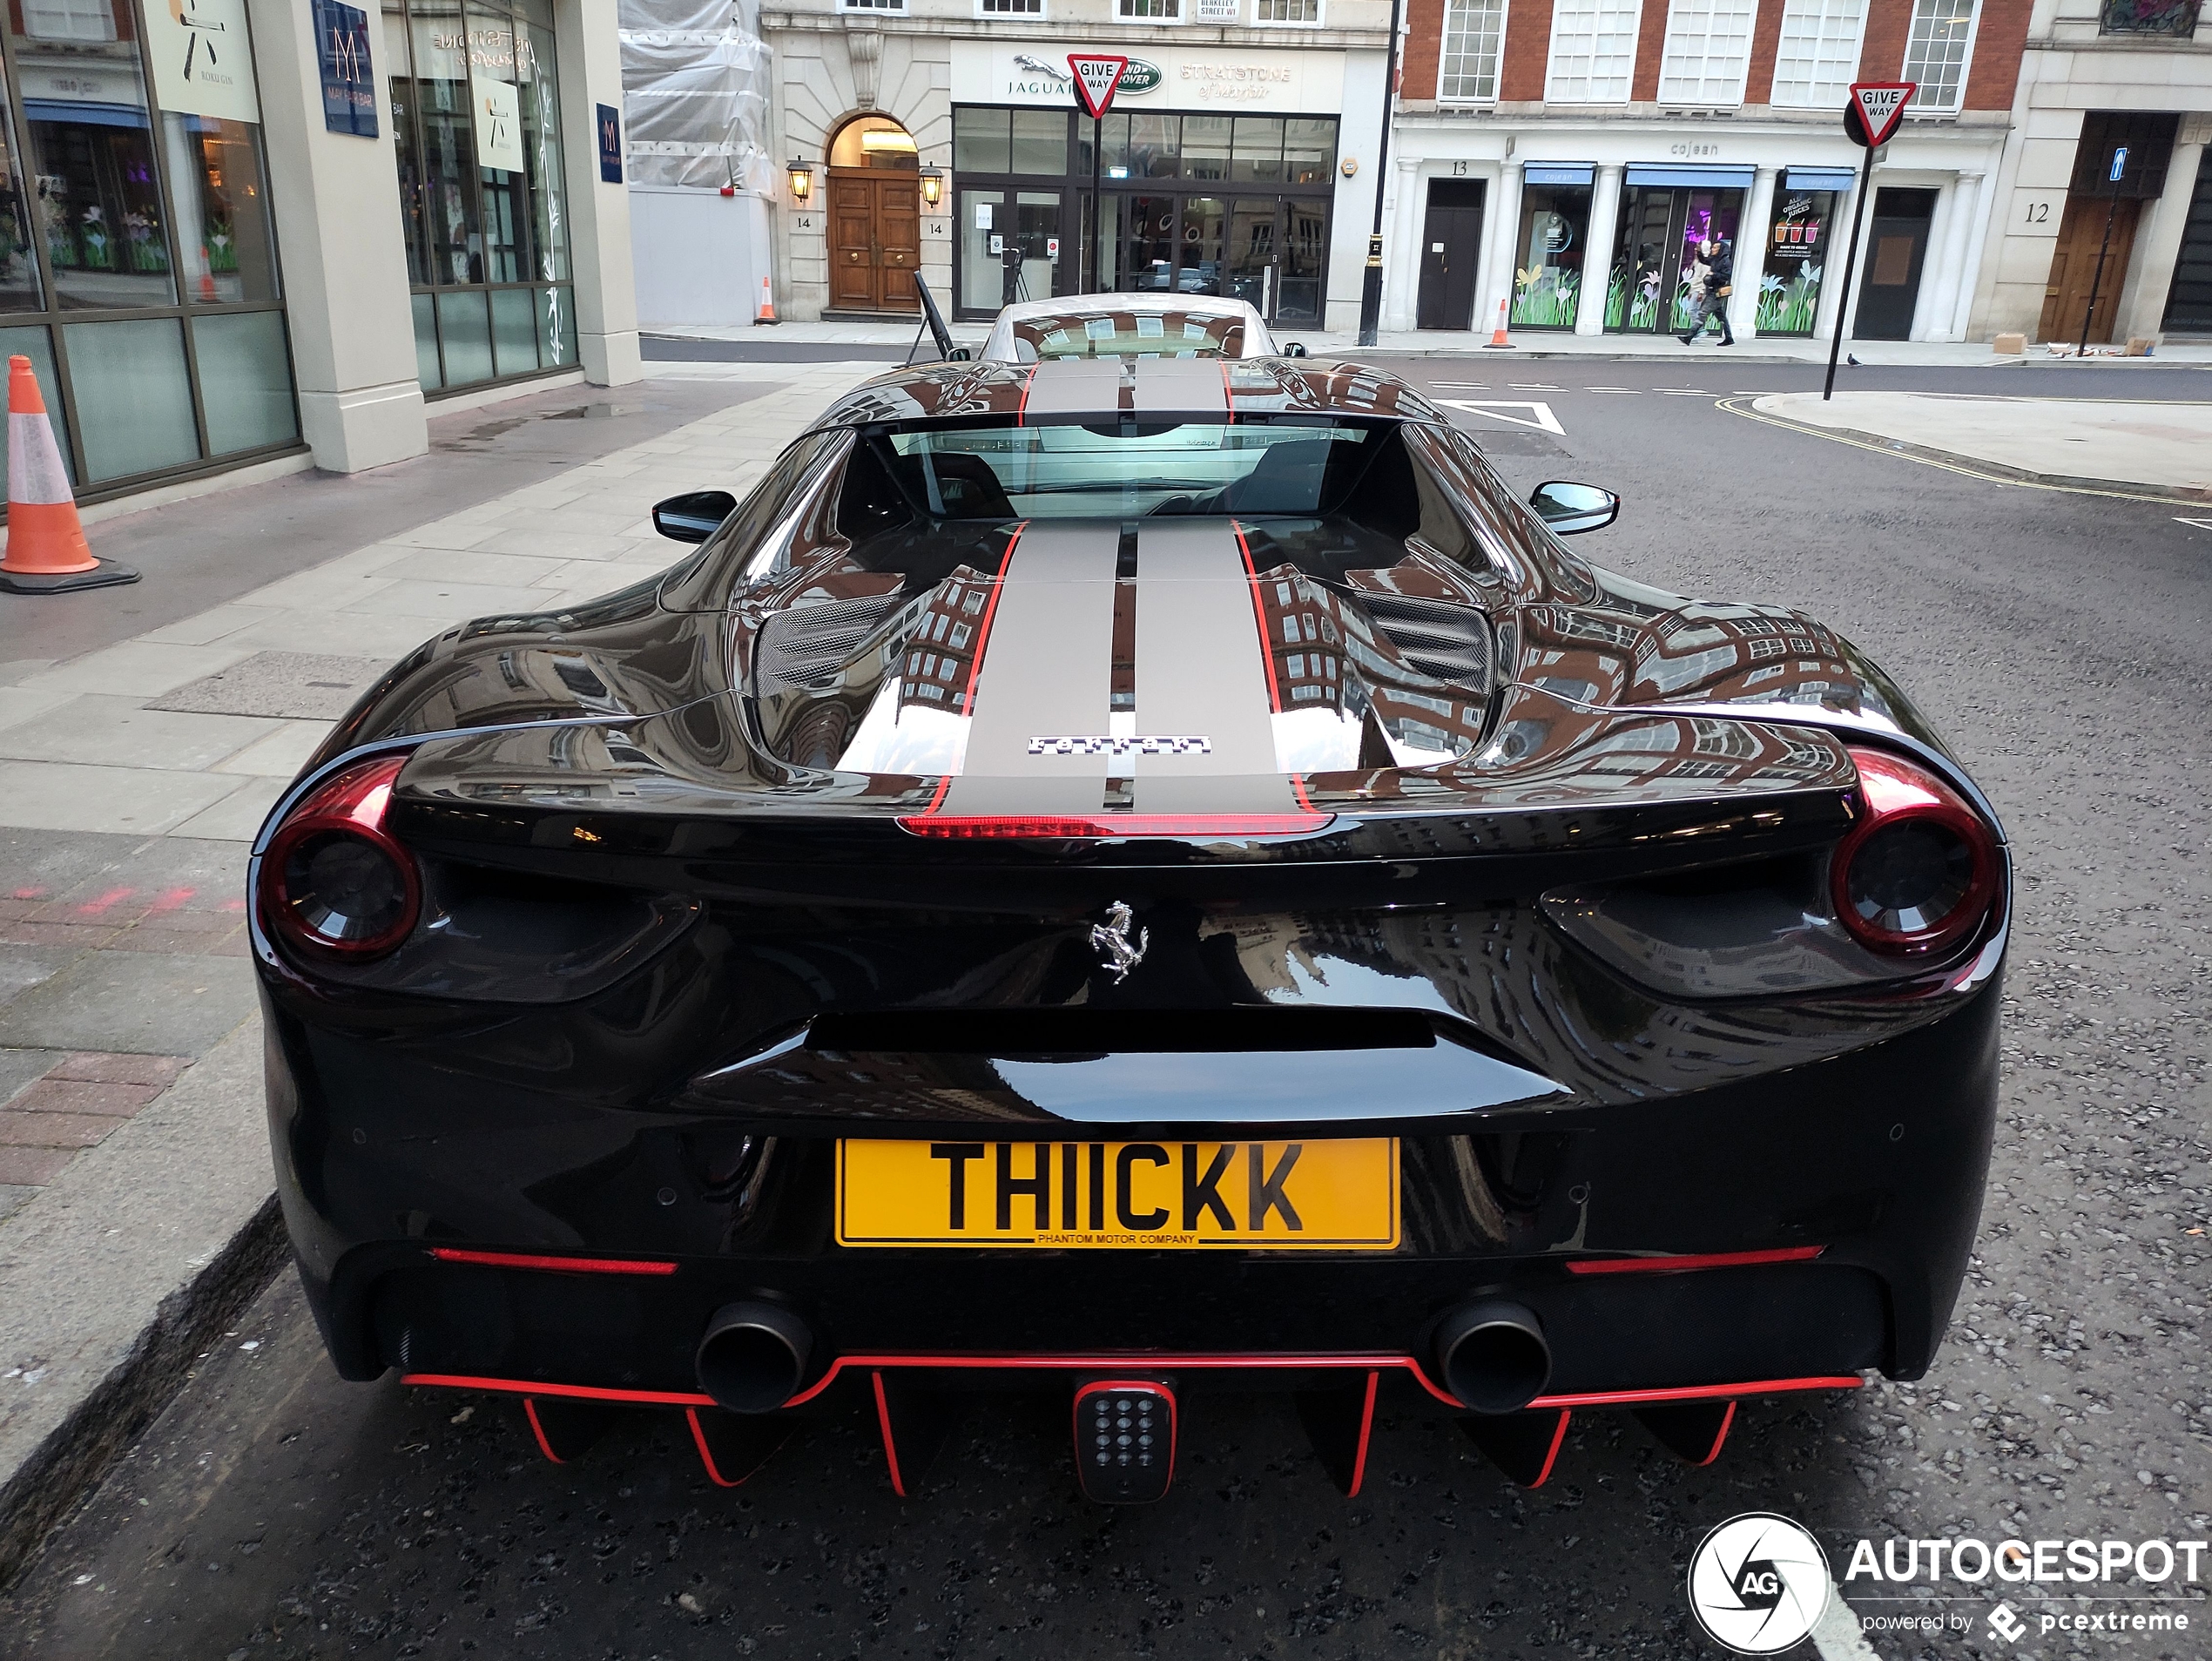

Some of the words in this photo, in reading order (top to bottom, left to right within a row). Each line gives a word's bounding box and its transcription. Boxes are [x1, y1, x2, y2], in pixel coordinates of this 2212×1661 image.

[1081, 63, 1114, 76] GIVE
[1180, 64, 1291, 82] STRATSTONE
[201, 71, 219, 83] ROKU
[220, 74, 233, 84] GIN
[1088, 79, 1109, 89] WAY
[327, 86, 343, 99] MAY
[359, 92, 373, 107] BAR
[1215, 82, 1271, 101] Mayfair
[1863, 91, 1899, 104] GIVE
[1869, 107, 1892, 116] WAY
[1670, 140, 1718, 158] cojean
[1452, 161, 1467, 176] 13
[1545, 173, 1573, 183] cojean
[1783, 198, 1812, 213] ORGANIC
[1788, 204, 1810, 219] JUICES
[2025, 203, 2049, 223] 12
[798, 218, 811, 228] 14
[930, 224, 942, 234] 14
[1028, 738, 1212, 755] Ferrari
[1038, 1234, 1093, 1244] PHANTOM
[1096, 1234, 1136, 1244] MOTOR
[1140, 1234, 1196, 1244] COMPANY
